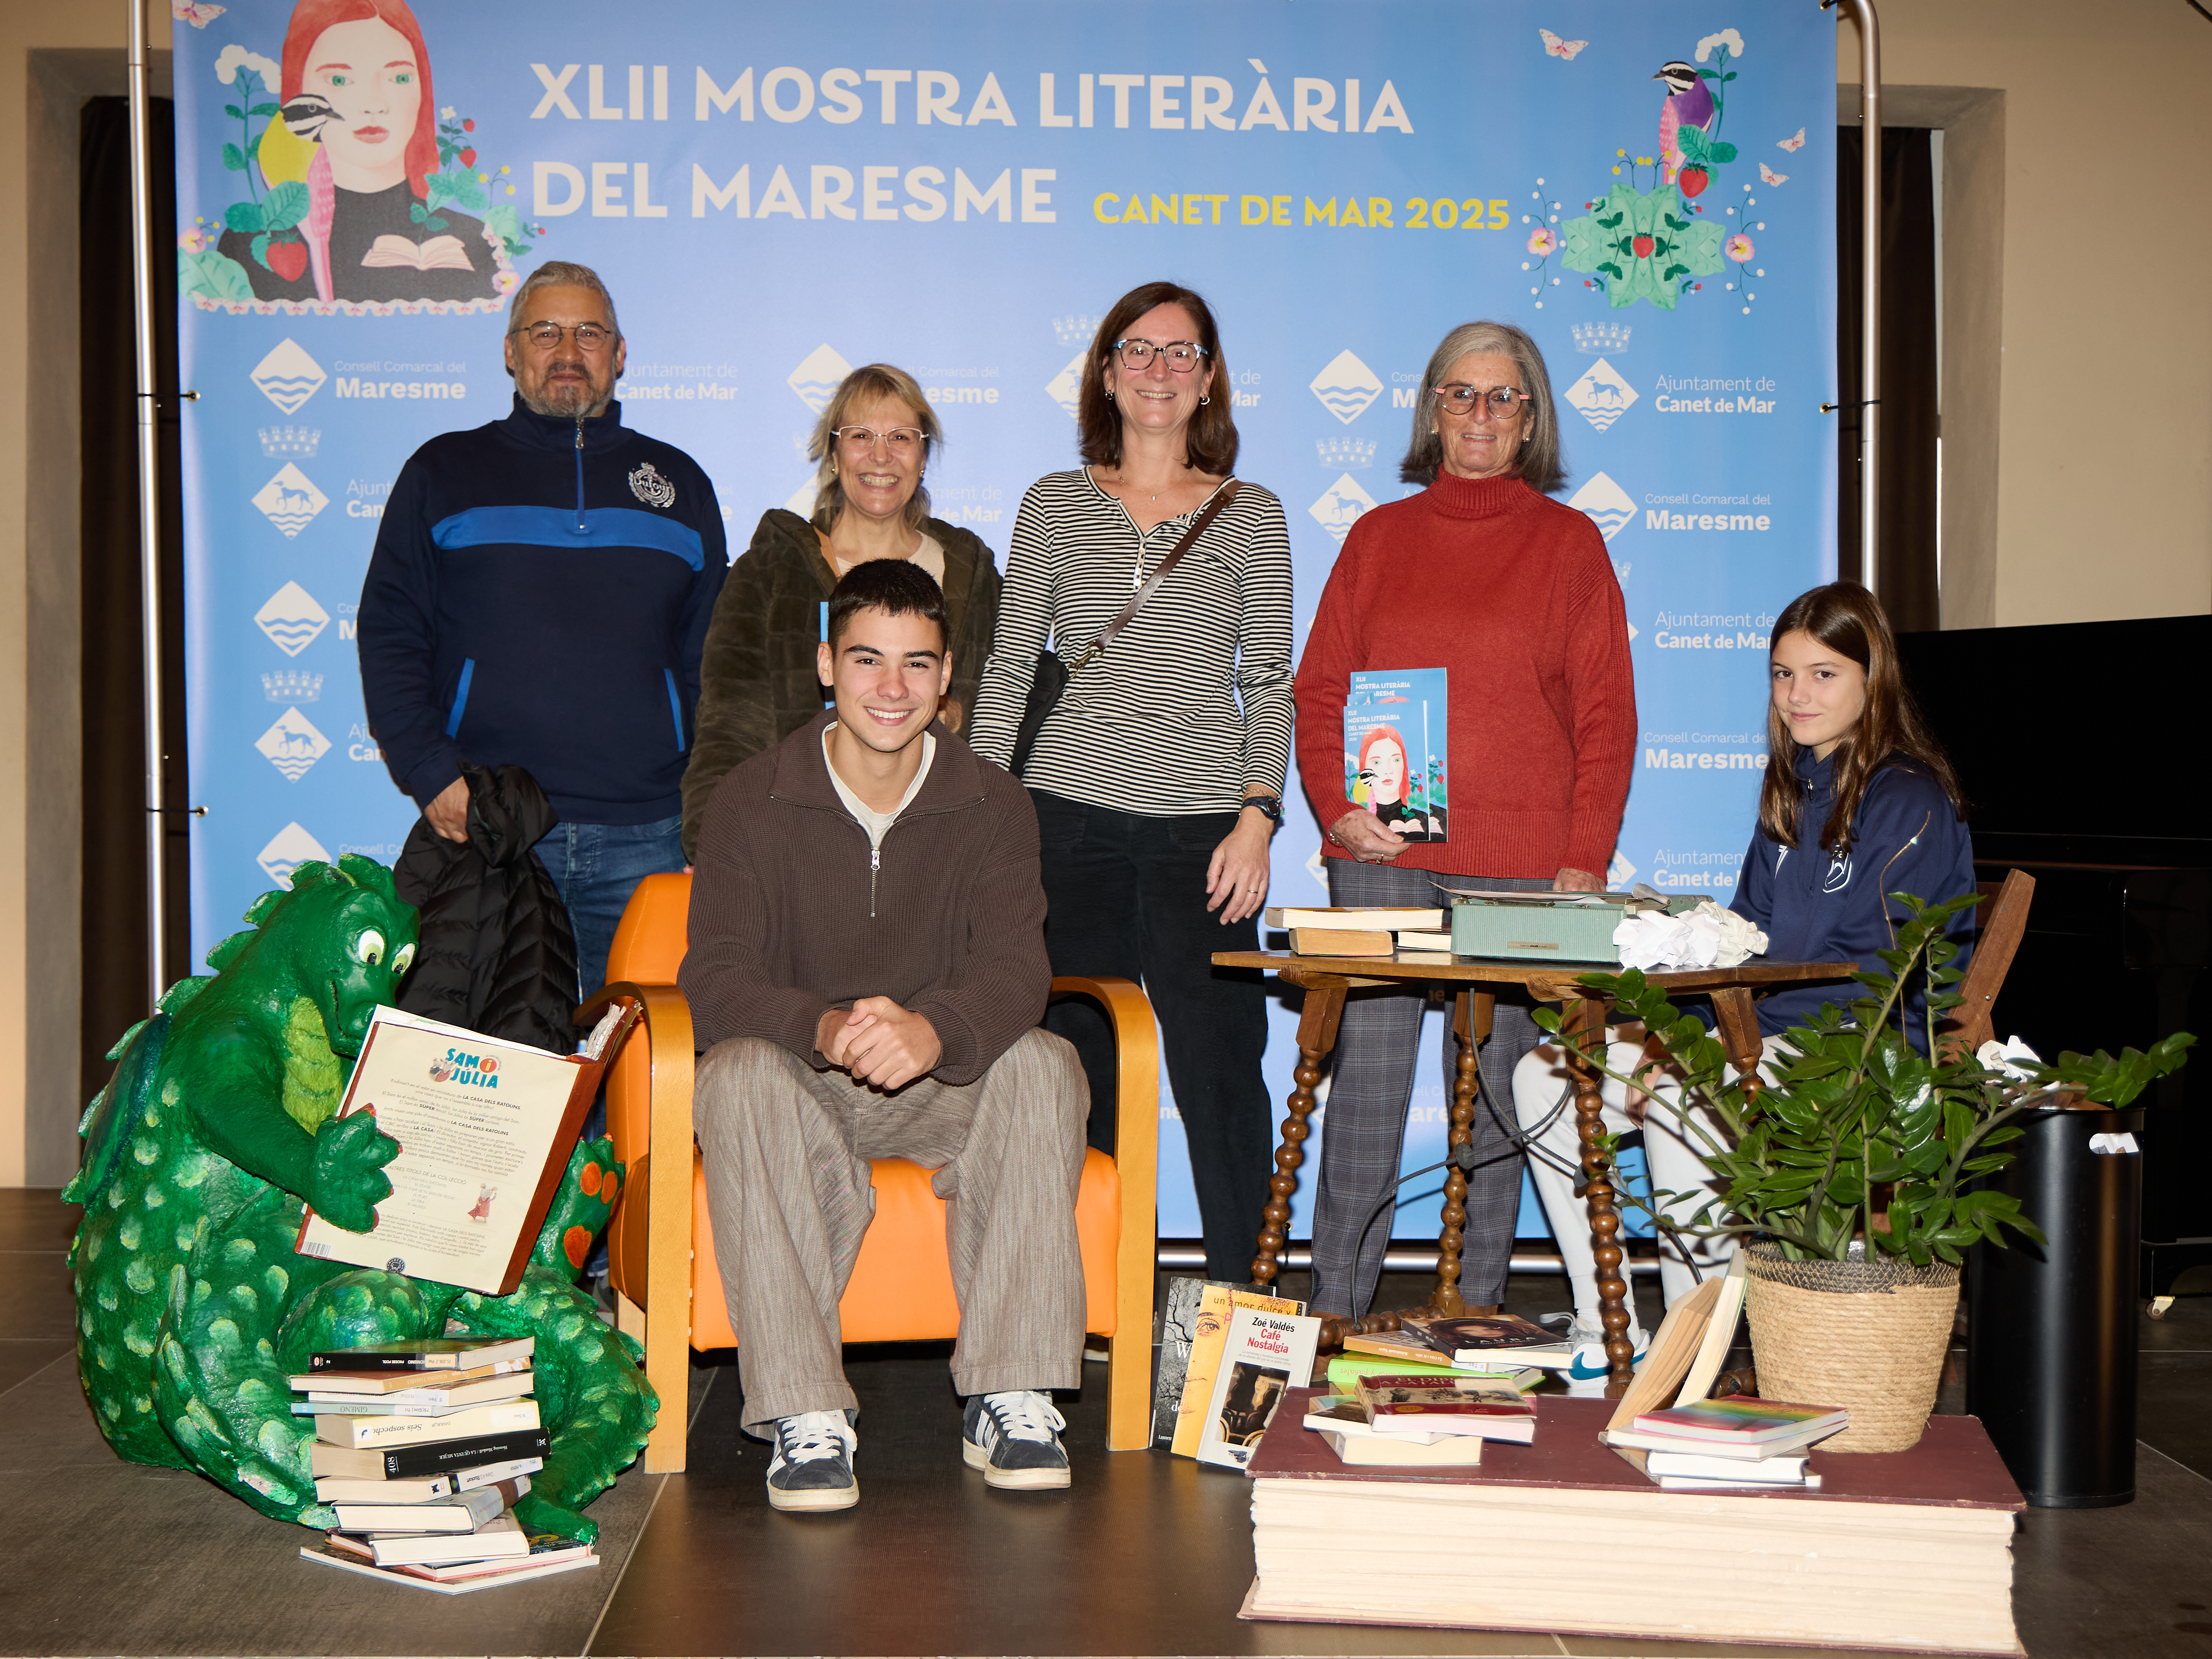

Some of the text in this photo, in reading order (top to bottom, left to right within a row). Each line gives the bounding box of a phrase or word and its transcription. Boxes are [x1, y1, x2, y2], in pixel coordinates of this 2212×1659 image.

[530, 58, 1414, 134] XLII MOSTRA LITERÀRIA
[533, 161, 1057, 223] DEL MARESME
[1093, 192, 1509, 230] CANET DE MAR 2025
[334, 360, 467, 373] Consell Comarcal del
[717, 362, 738, 378] de
[918, 366, 977, 378] Comarcal
[980, 366, 999, 378] del
[1240, 369, 1261, 385] de
[1655, 374, 1776, 394] Ajuntament de
[336, 377, 466, 400] Maresme
[615, 381, 738, 400] Canet de Mar
[1655, 394, 1776, 414] Canet de Mar
[634, 476, 671, 492] Dufour
[981, 485, 1002, 501] de
[1645, 493, 1771, 505] Consell Comarcal del
[939, 505, 1003, 523] de Mar
[1646, 510, 1771, 531] Maresme
[1655, 611, 1775, 627] Ajuntament de
[1655, 631, 1712, 649] Canet
[1714, 634, 1734, 649] de
[1381, 681, 1411, 689] LITERÀRIA
[1371, 713, 1400, 722] LITERÀRIA
[1643, 732, 1688, 743] Consell
[1691, 732, 1749, 743] Comarcal
[1645, 748, 1768, 769] Maresme
[1653, 869, 1734, 887] Canet de
[445, 1048, 480, 1069] SAM
[486, 1059, 493, 1071] i
[450, 1067, 499, 1089] JÚLIA
[388, 1164, 405, 1172] ALTRES
[1213, 1296, 1225, 1305] un
[1229, 1297, 1255, 1310] amor
[1257, 1301, 1283, 1314] dulce
[1252, 1317, 1295, 1333] Zoé Valdés
[1261, 1328, 1280, 1341] Café
[1247, 1337, 1289, 1354] Nostalgia
[426, 1374, 448, 1382] SUSANNA
[1340, 1368, 1369, 1376] pañales
[407, 1423, 422, 1432] Seis
